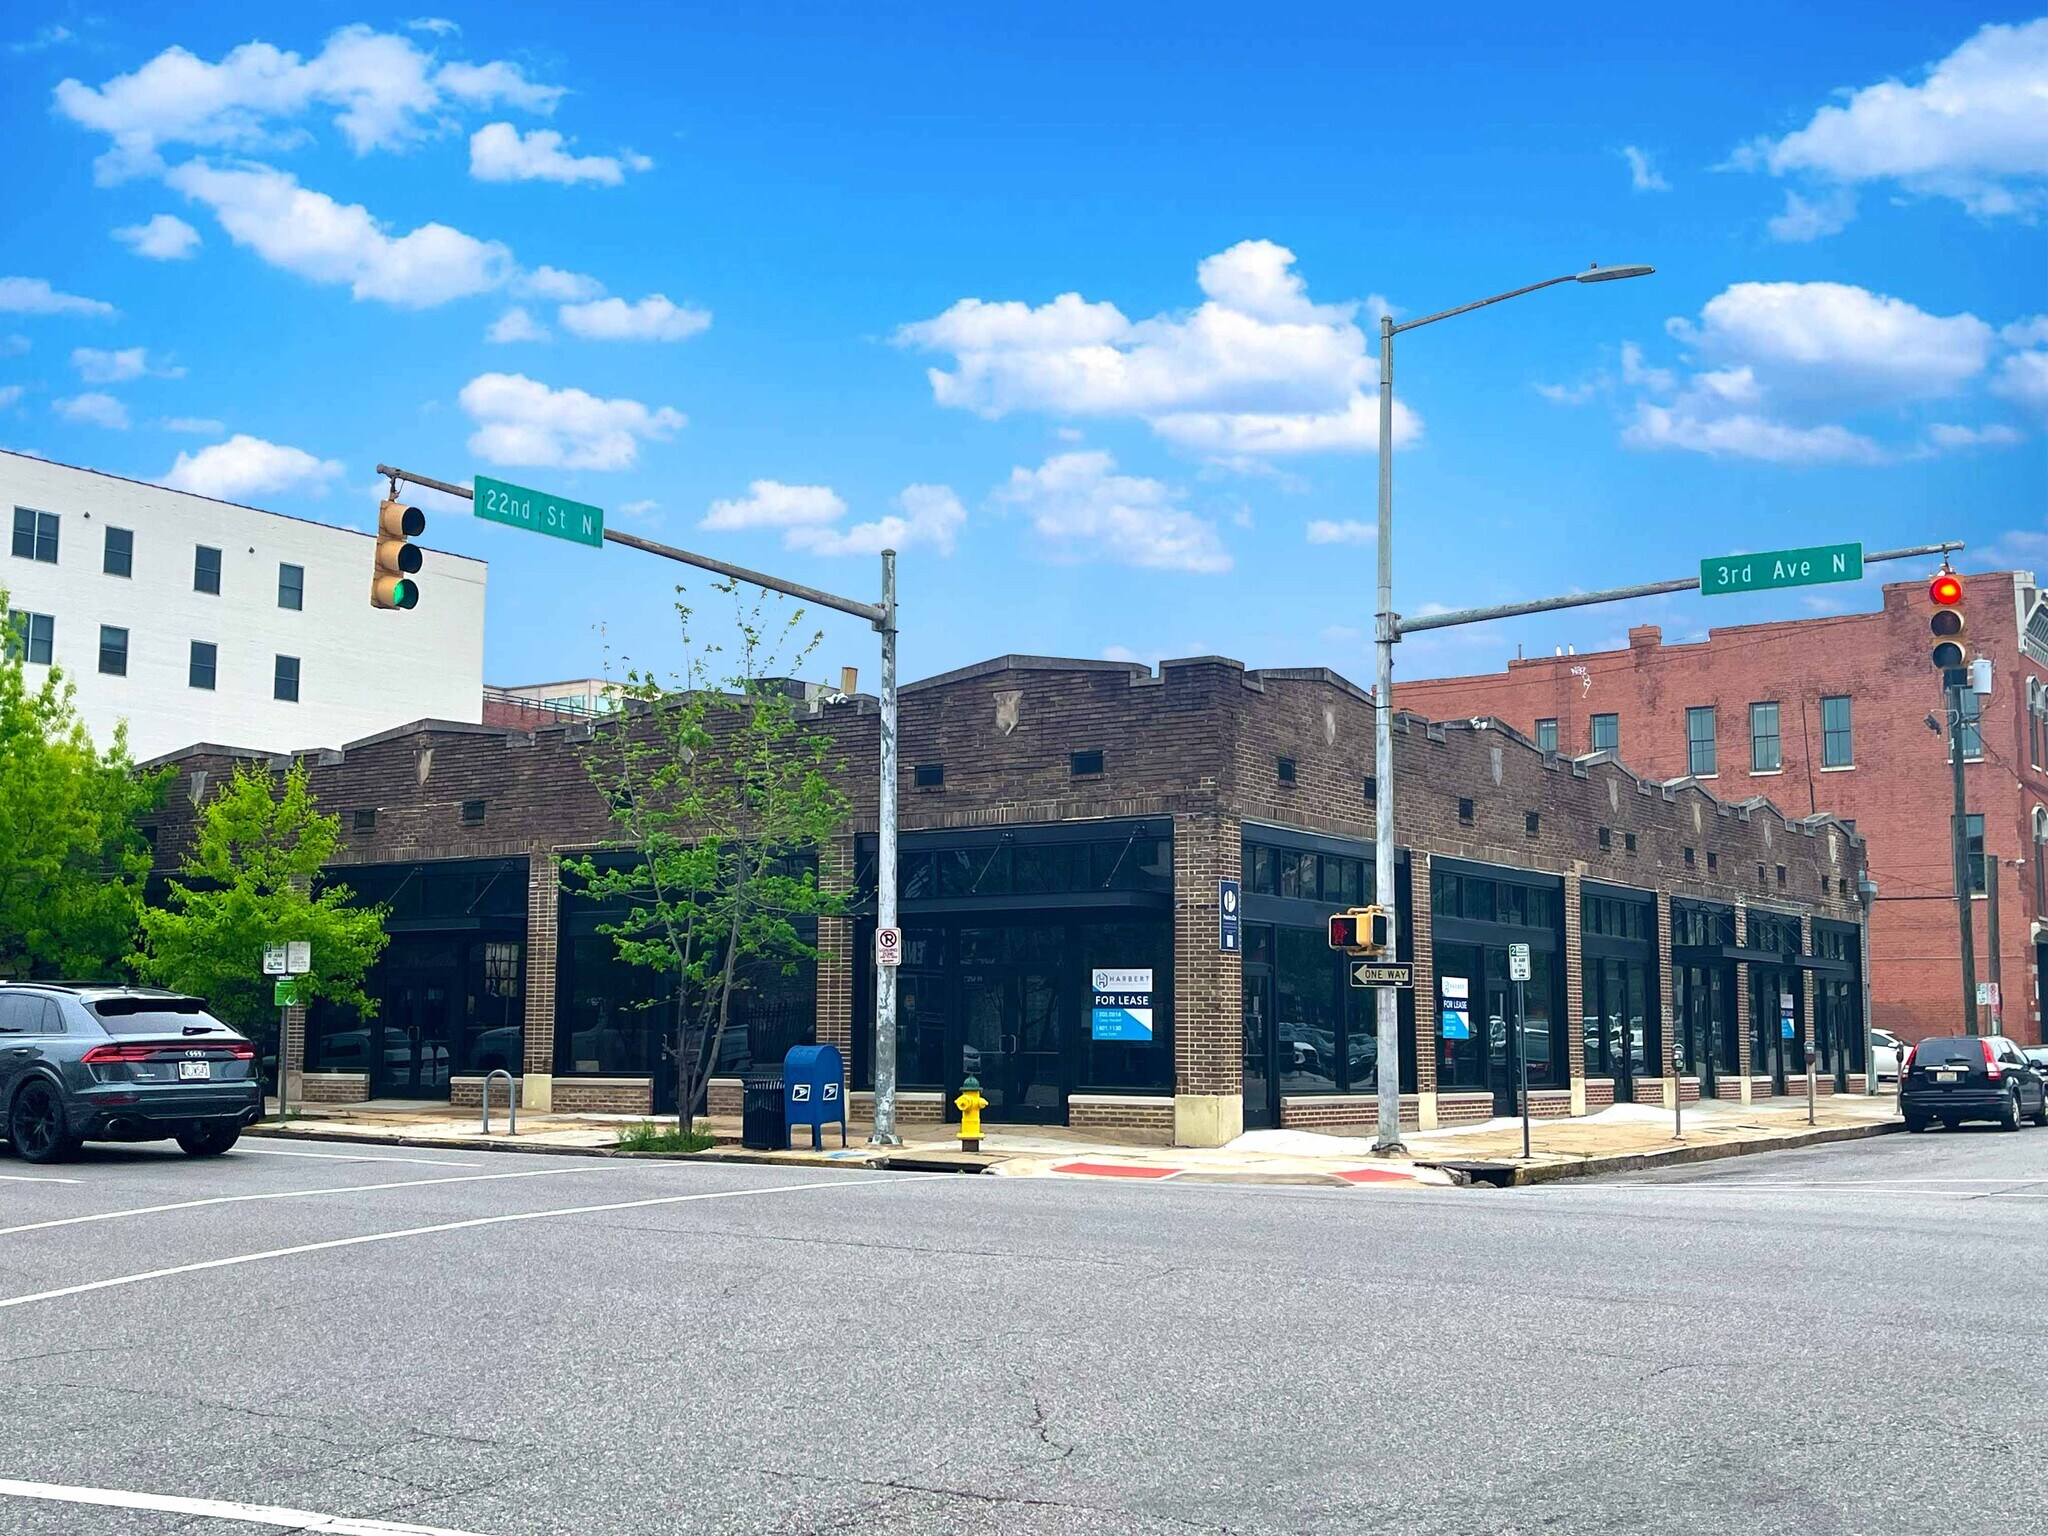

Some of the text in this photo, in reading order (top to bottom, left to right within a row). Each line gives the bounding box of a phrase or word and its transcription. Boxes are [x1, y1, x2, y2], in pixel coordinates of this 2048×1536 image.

[486, 489, 592, 536] 22nd St N
[1718, 553, 1845, 585] 3rd Ave N
[1511, 946, 1516, 955] 2
[1109, 975, 1150, 983] HARBERT
[1365, 970, 1407, 979] ONE WAY
[1095, 995, 1149, 1006] FOR LEASE
[1443, 999, 1467, 1010] FOR LEASE
